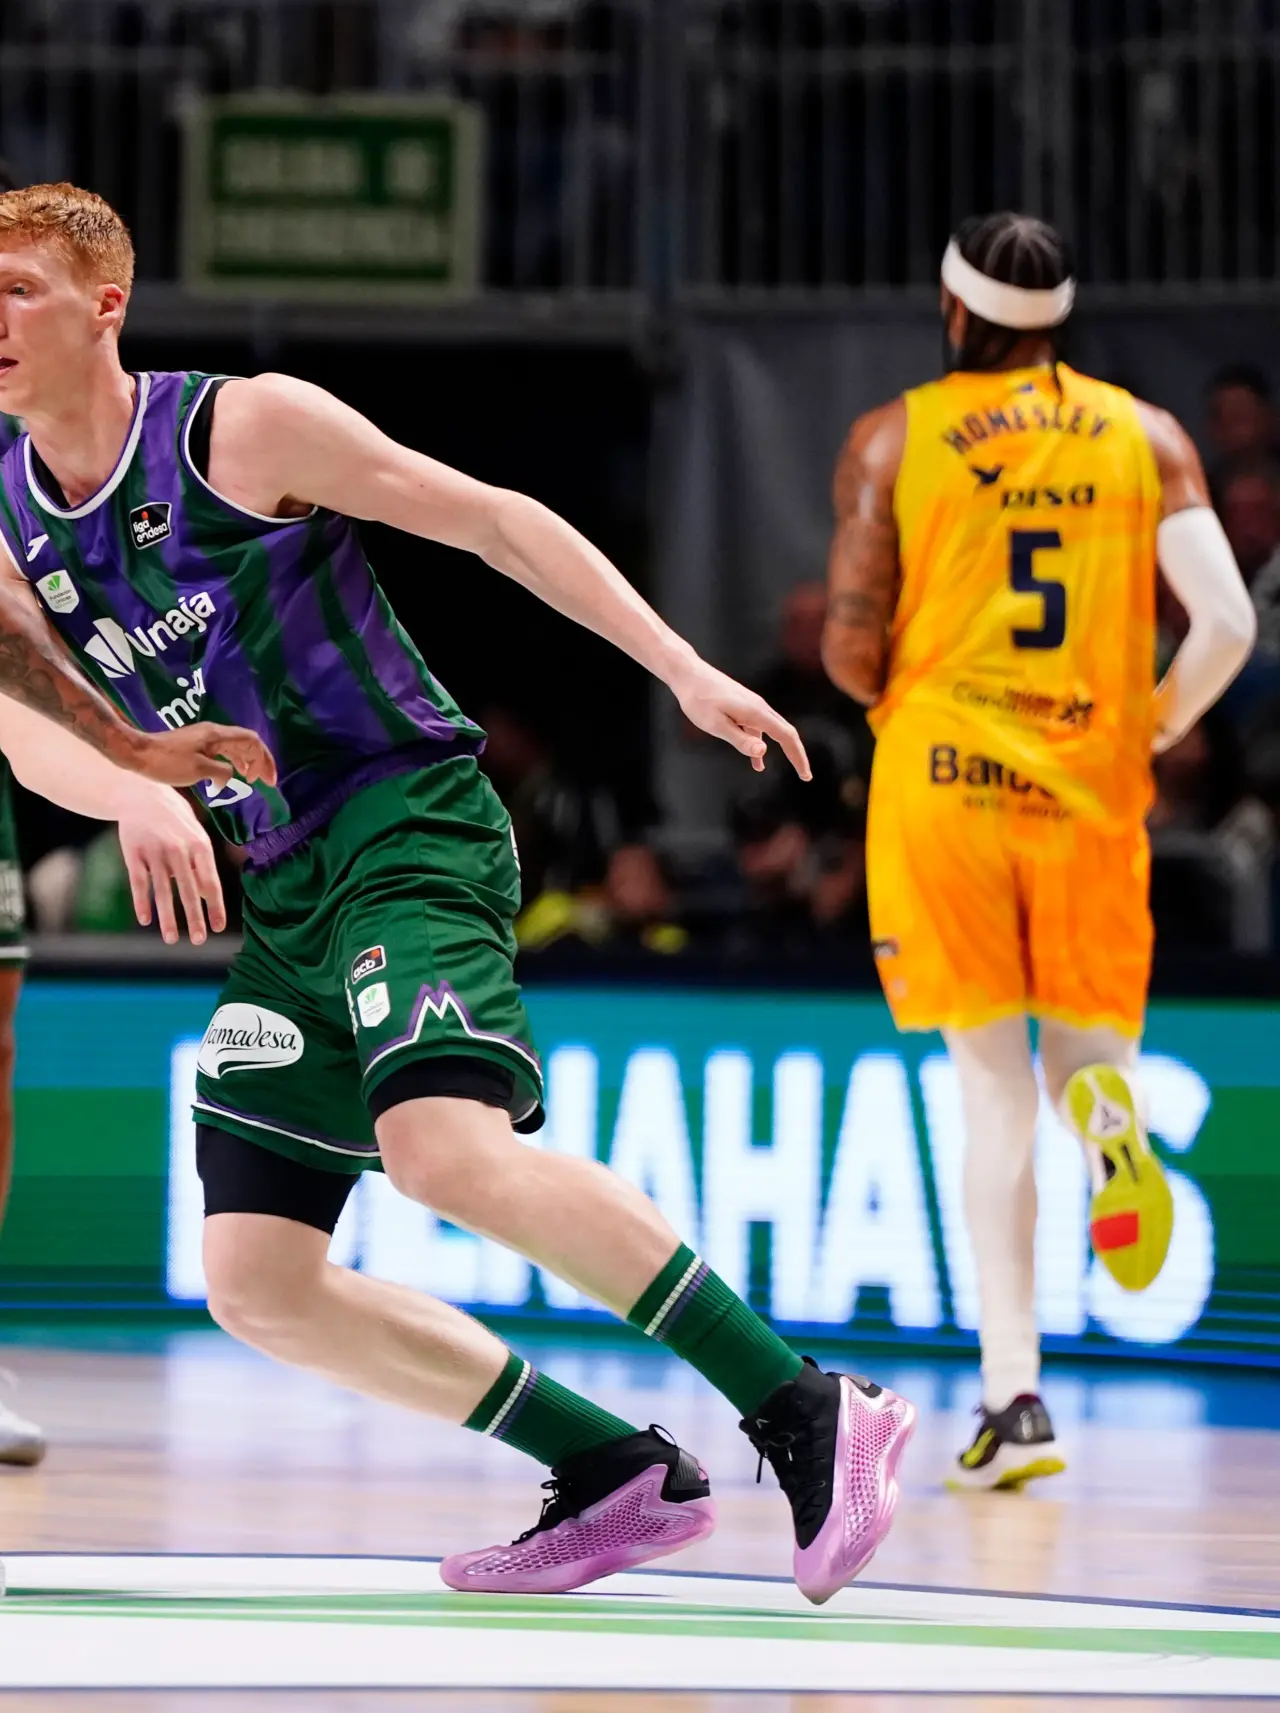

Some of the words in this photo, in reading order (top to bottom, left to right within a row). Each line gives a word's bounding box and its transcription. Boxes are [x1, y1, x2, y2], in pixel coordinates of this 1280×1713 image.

[132, 519, 150, 533] liga
[136, 522, 168, 543] endesa
[1009, 529, 1067, 651] 5
[353, 959, 376, 979] acb
